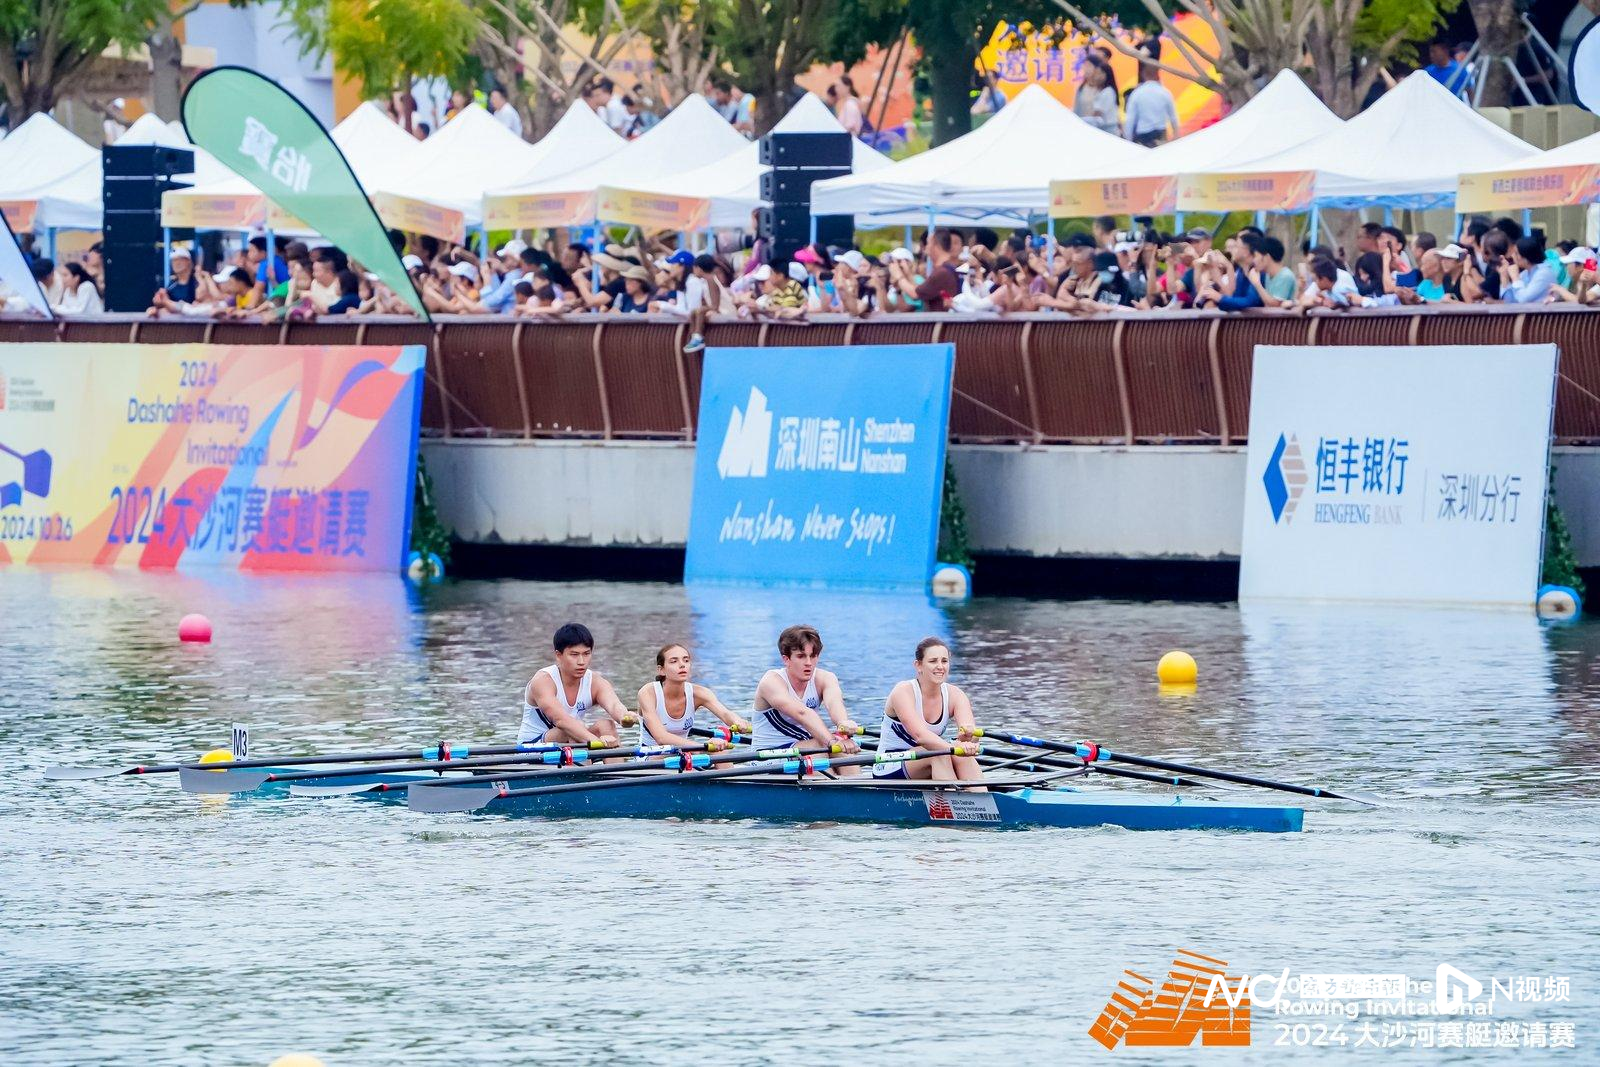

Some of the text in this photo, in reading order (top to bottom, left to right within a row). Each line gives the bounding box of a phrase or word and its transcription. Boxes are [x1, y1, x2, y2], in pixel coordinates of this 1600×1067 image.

[180, 361, 218, 386] 2024
[127, 398, 249, 432] Dashahe Rowing
[775, 416, 861, 472] 深圳南山
[864, 417, 916, 444] Shenzhen
[187, 439, 269, 466] Invitational
[860, 448, 908, 474] Nanshan
[1316, 437, 1409, 495] 恒丰银行
[1438, 473, 1522, 522] 深圳分行
[719, 498, 796, 546] Nanshan
[800, 503, 845, 541] Never
[1314, 503, 1403, 525] HENGFENG BANK
[233, 728, 248, 757] M3
